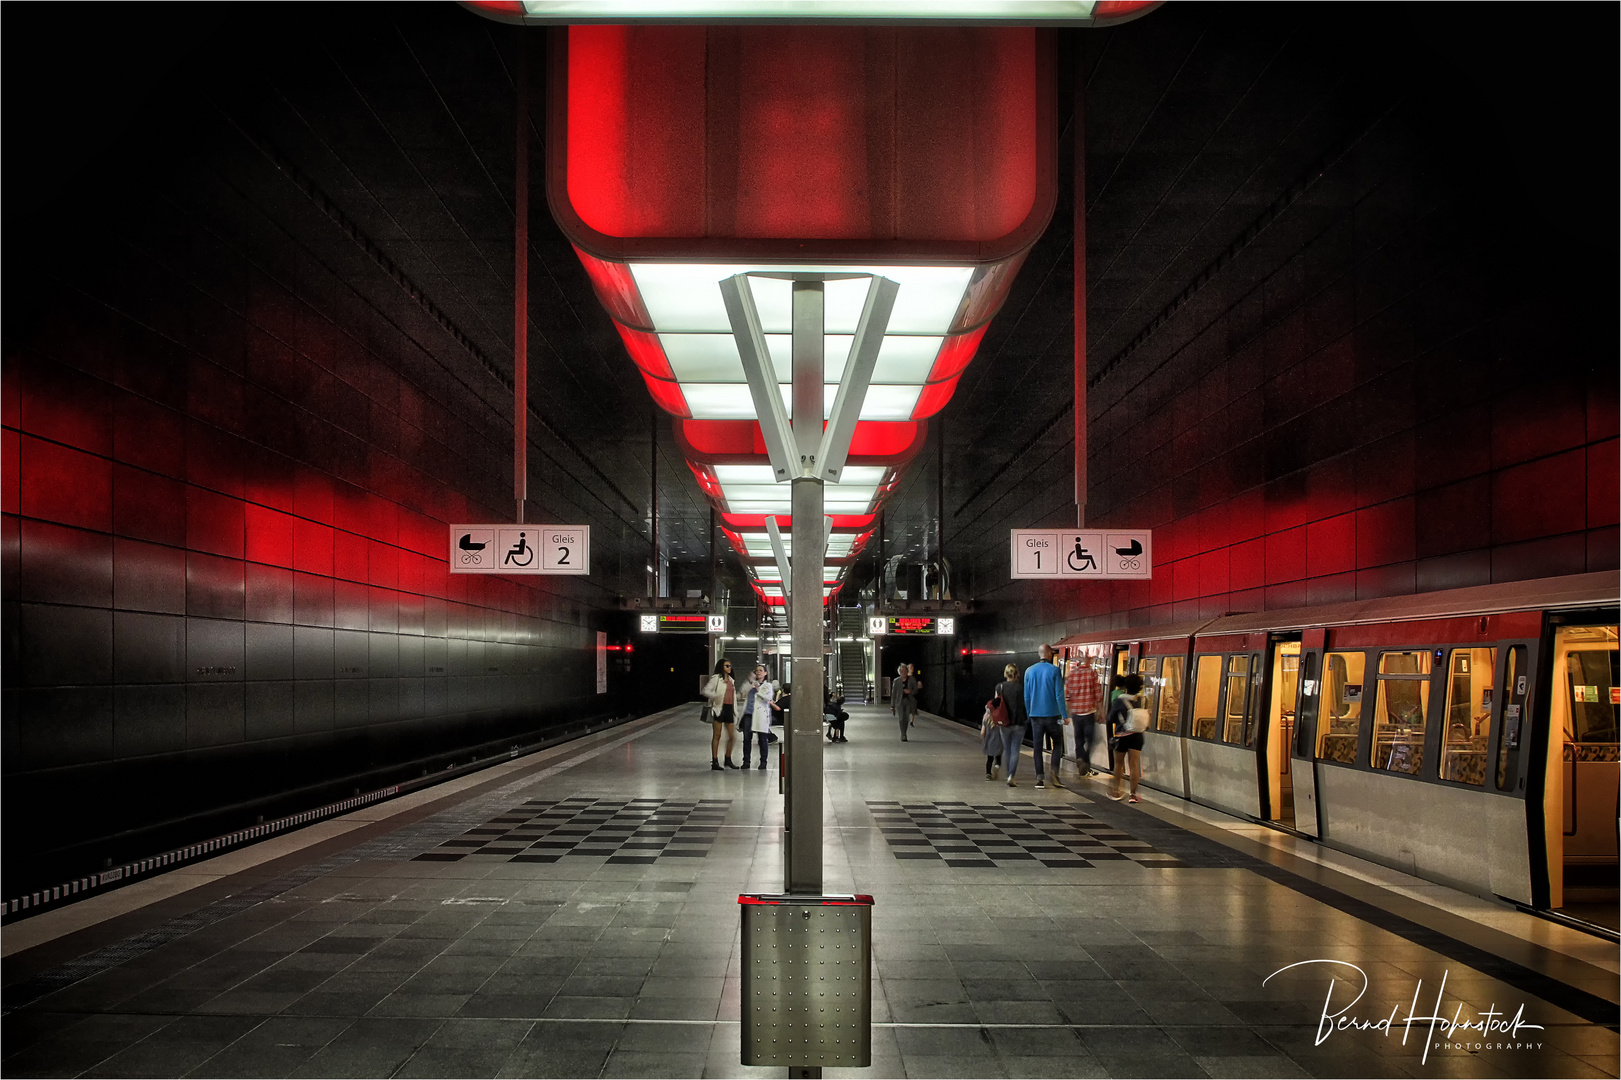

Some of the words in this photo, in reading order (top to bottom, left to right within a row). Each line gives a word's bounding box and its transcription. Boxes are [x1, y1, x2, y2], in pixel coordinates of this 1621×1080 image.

[552, 534, 575, 544] Gleis
[1026, 538, 1049, 548] Gleis
[557, 546, 570, 565] 2
[1033, 550, 1041, 570] 1
